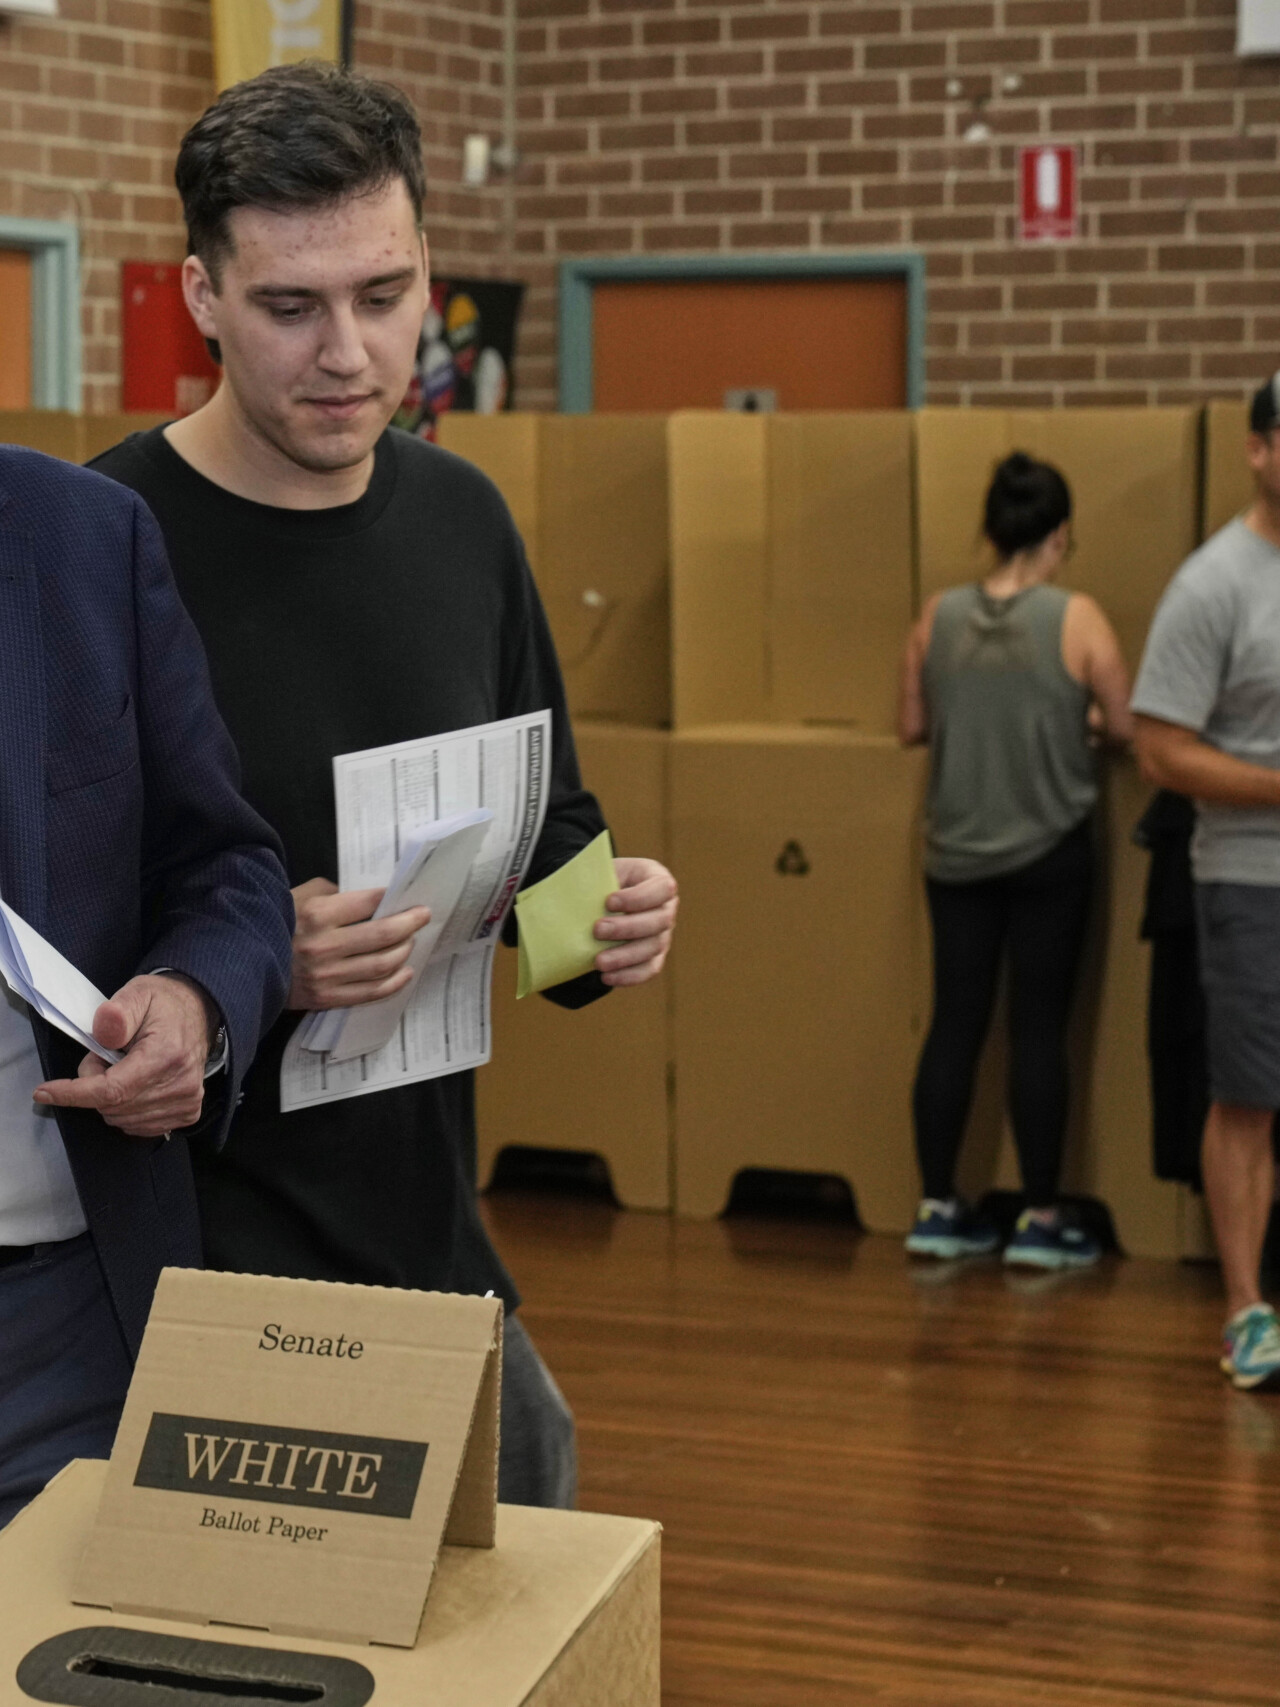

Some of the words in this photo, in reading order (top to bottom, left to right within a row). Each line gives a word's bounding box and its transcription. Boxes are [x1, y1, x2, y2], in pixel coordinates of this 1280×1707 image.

[528, 729, 543, 800] AUSTRALIAN
[522, 801, 538, 839] LABOR
[512, 839, 529, 871] PARTY
[258, 1323, 365, 1360] Senate
[183, 1431, 383, 1500] WHITE
[198, 1507, 261, 1535] Ballot
[265, 1516, 329, 1544] Paper
